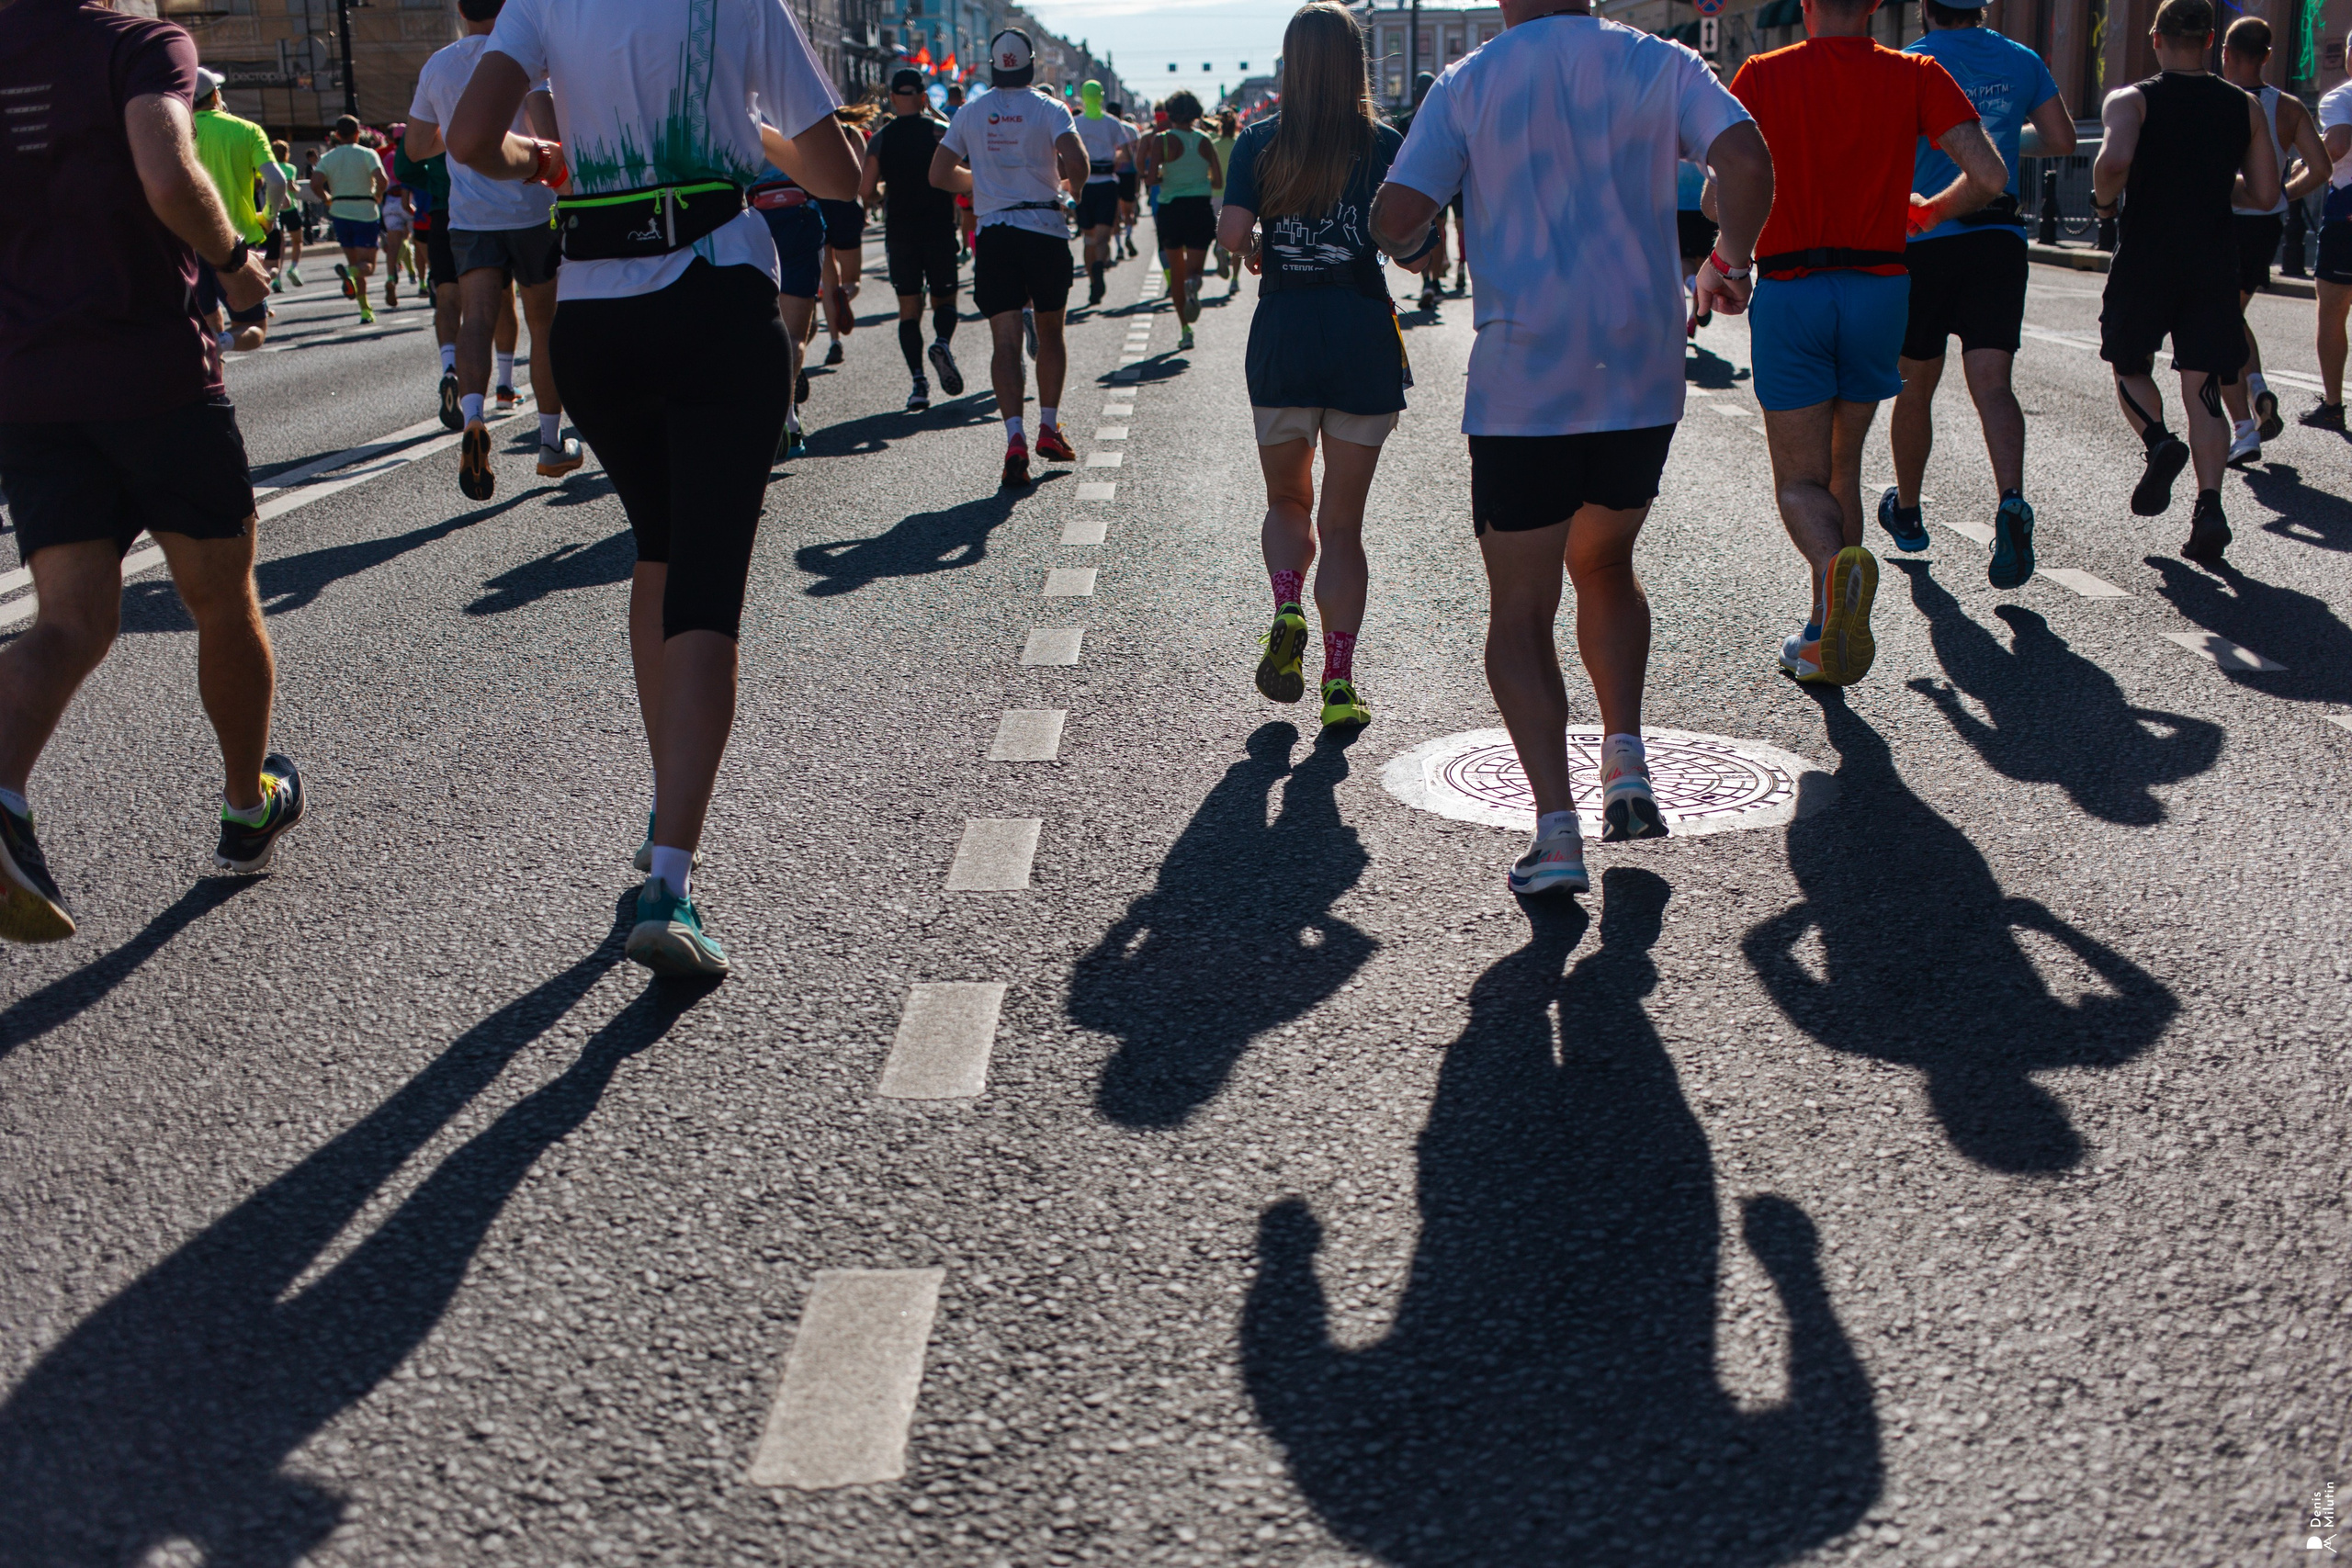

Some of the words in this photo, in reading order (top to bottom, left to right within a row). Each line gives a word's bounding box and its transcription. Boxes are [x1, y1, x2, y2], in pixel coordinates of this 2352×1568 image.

[1980, 84, 2009, 97] РИТМ
[1978, 97, 2008, 111] ПУТЬ
[1001, 115, 1023, 123] МКБ
[1336, 638, 1344, 649] ME
